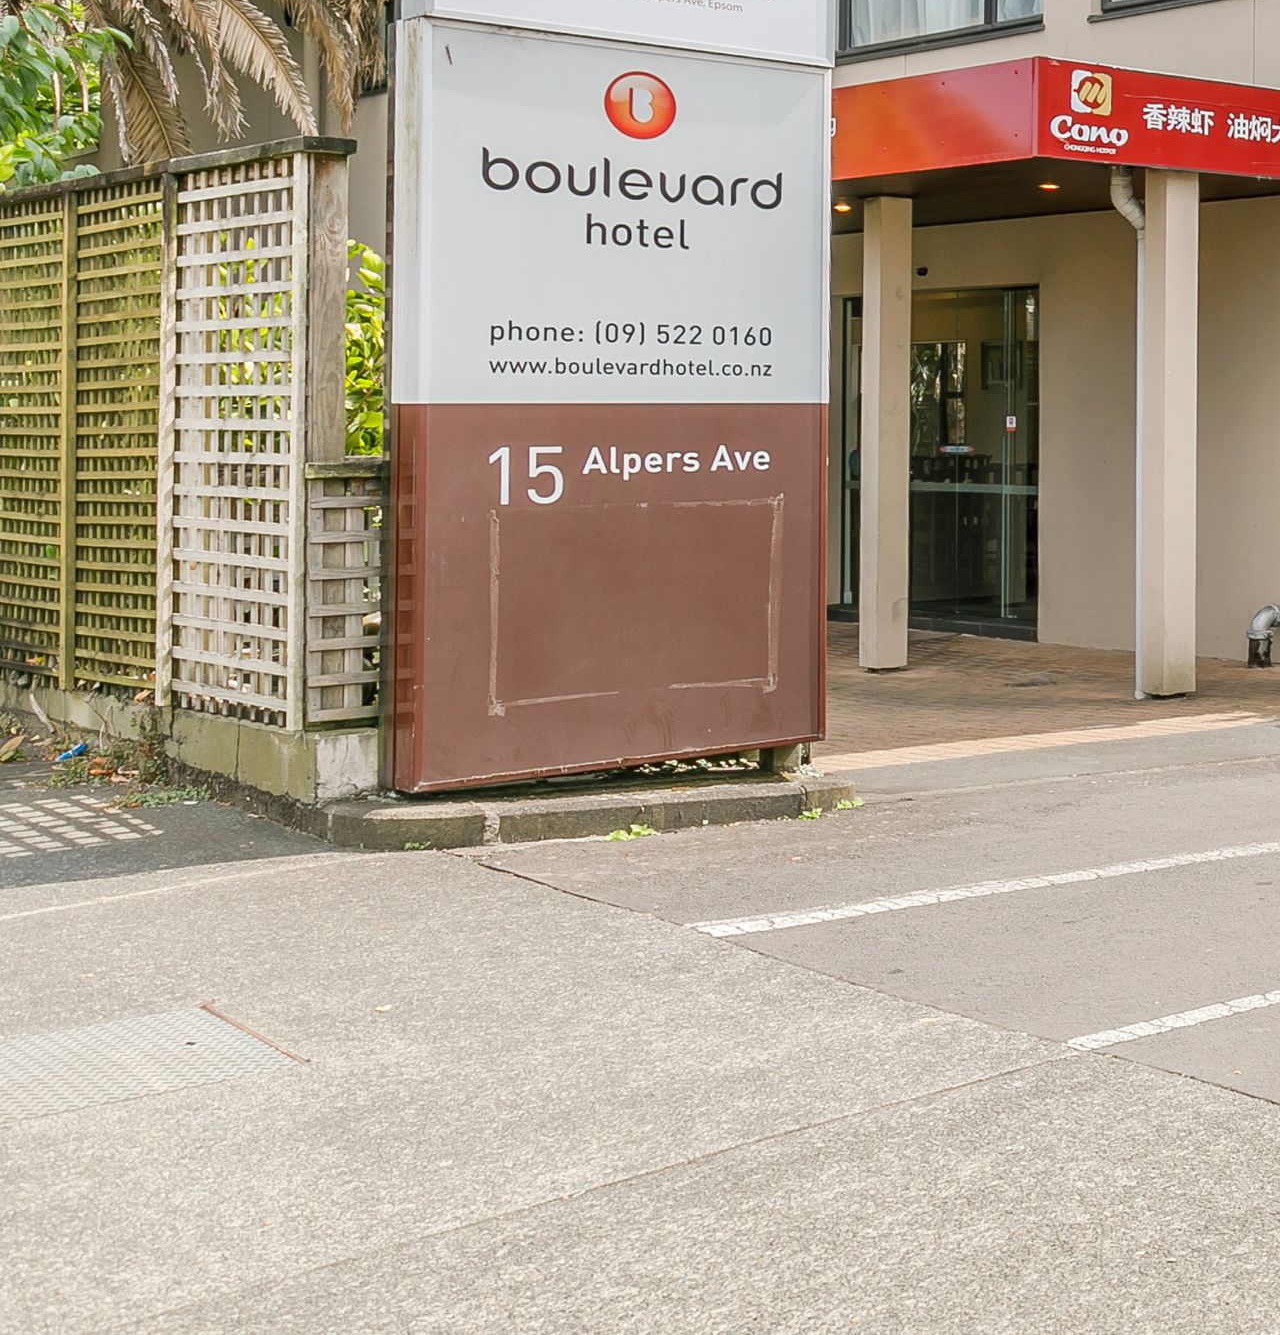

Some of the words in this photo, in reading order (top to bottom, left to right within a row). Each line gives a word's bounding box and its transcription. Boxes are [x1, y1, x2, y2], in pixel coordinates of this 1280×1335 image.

[1050, 114, 1129, 146] Cano
[1142, 103, 1215, 136] 香辣虾
[482, 146, 783, 210] boulevard
[585, 213, 689, 250] hotel
[489, 321, 584, 346] phone:
[595, 322, 646, 346] (09)
[656, 324, 702, 346] 522
[712, 325, 772, 347] 0160
[489, 358, 773, 378] www.boulevardhotel.co.nz
[487, 446, 564, 506] 15
[582, 446, 700, 480] Alpers
[711, 444, 771, 471] Ave
